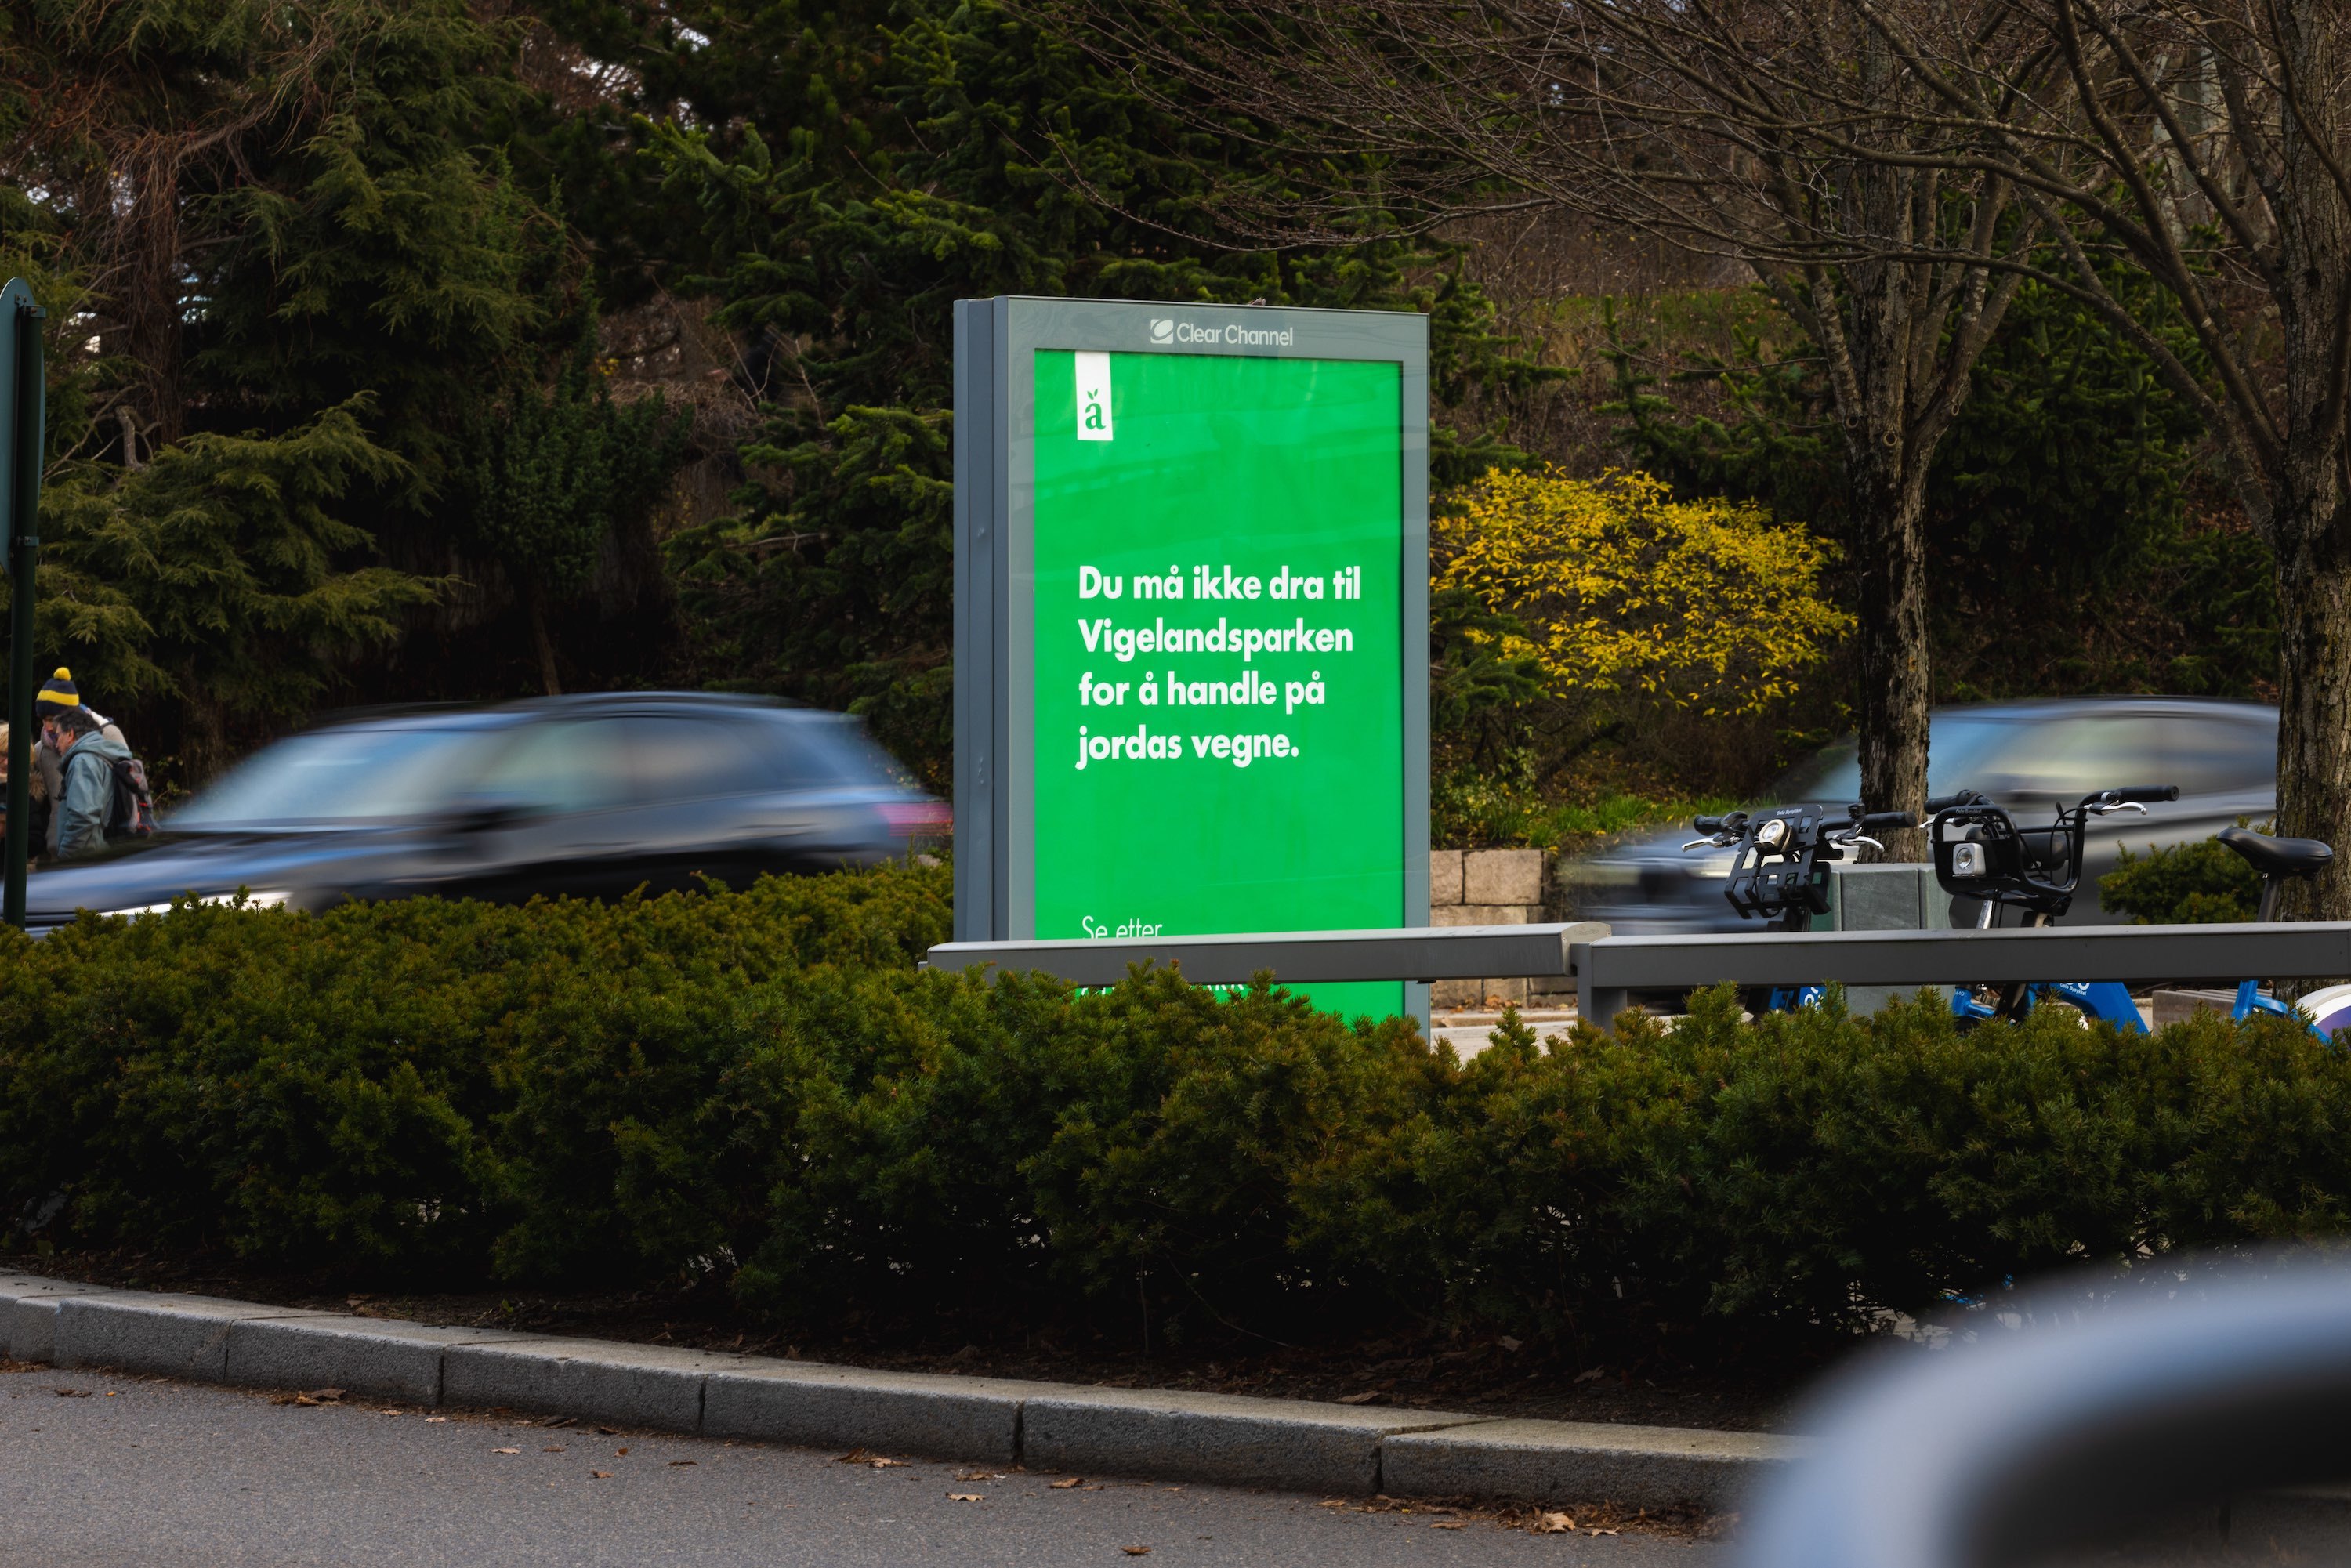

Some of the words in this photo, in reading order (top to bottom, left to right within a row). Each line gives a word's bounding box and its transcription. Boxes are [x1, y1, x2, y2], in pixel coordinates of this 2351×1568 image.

[1176, 323, 1222, 343] Clear
[1225, 324, 1293, 346] Channel
[1080, 566, 1122, 599] Du
[1134, 565, 1183, 599] må
[1194, 565, 1261, 599] ikke
[1270, 566, 1323, 599] dra
[1333, 566, 1360, 599] til
[1078, 618, 1353, 661] Vigelandsparken
[1079, 672, 1129, 705] for
[1139, 672, 1157, 705] å
[1168, 671, 1277, 705] handle
[1286, 671, 1324, 714] på
[1075, 725, 1182, 770] jordas
[1191, 734, 1299, 767] vegne.
[1082, 915, 1108, 939] Se
[1116, 918, 1163, 938] etter
